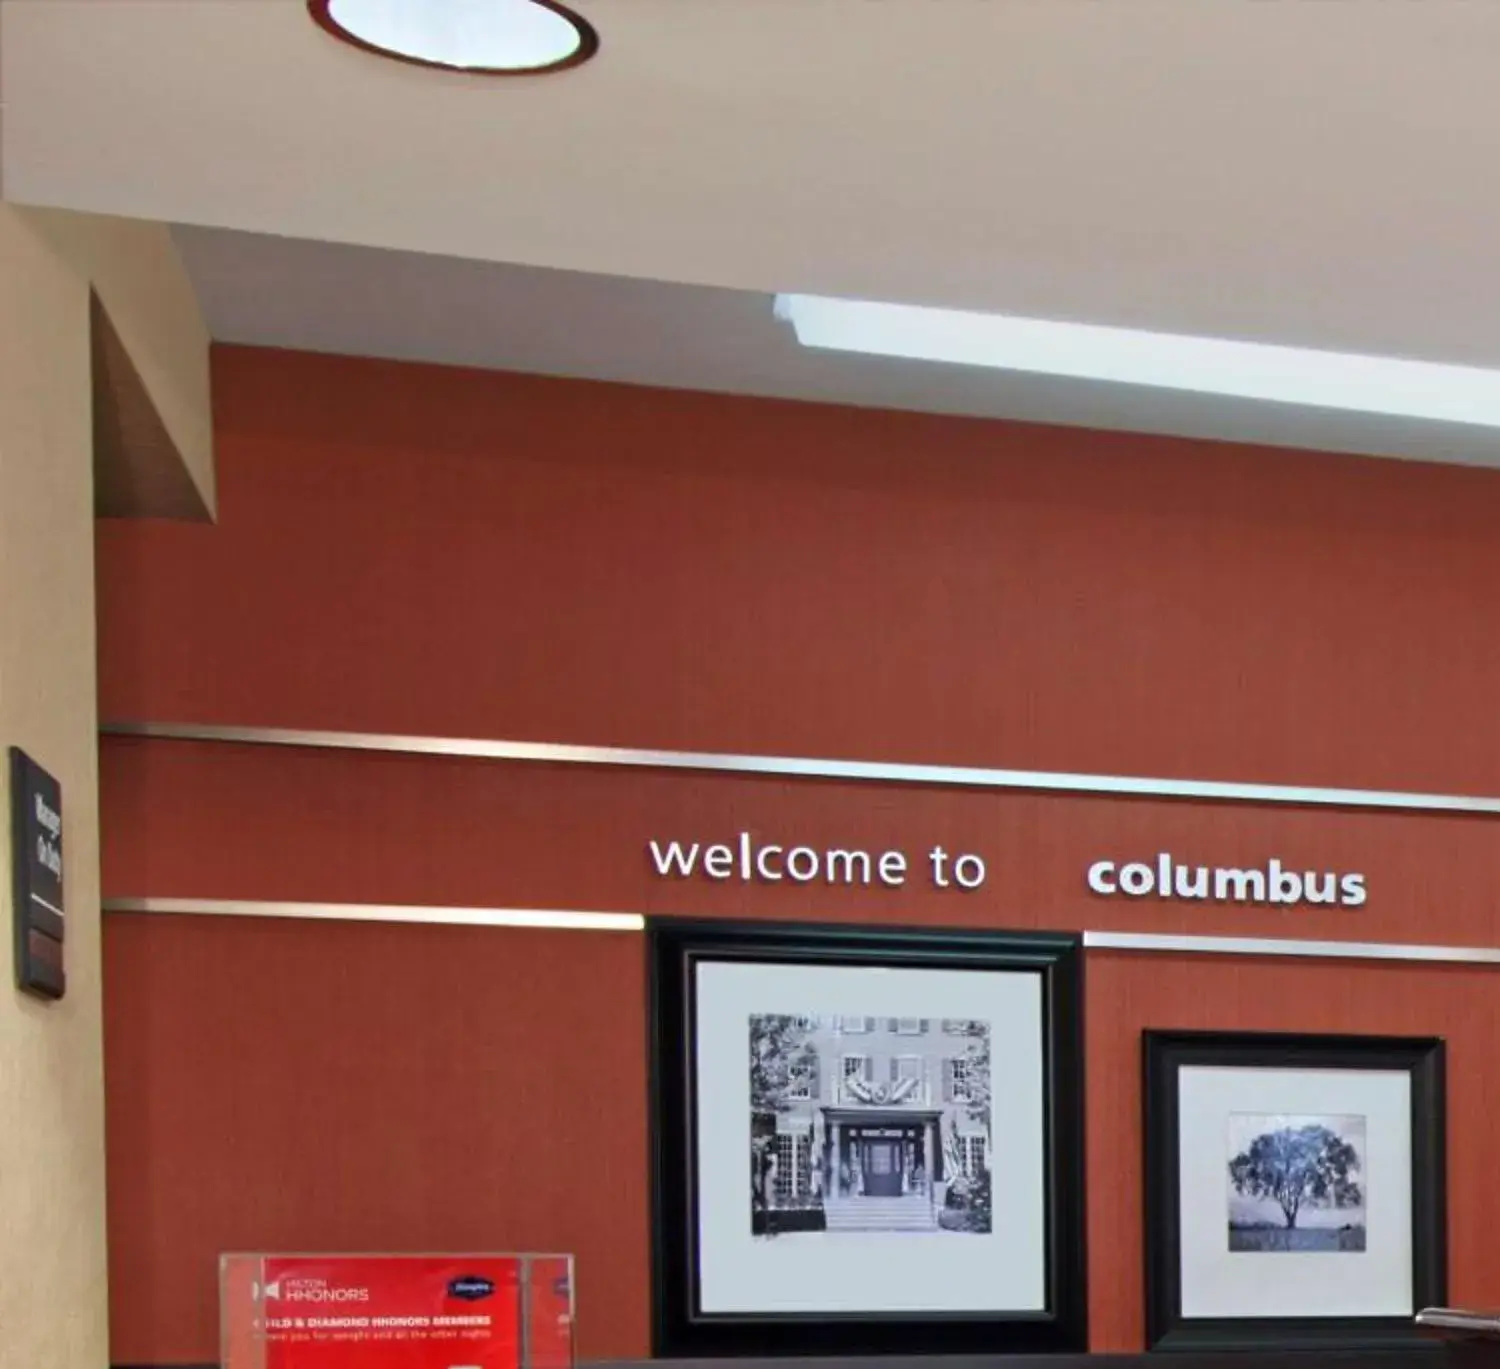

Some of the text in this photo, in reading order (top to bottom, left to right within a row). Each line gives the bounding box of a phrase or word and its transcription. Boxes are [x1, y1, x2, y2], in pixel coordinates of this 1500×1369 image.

[651, 832, 1366, 904] welcome to columbus
[286, 1288, 370, 1302] HHONORS
[307, 1317, 369, 1328] DIAMOND
[371, 1316, 430, 1328] HHONORS
[432, 1315, 491, 1327] MEMBERS
